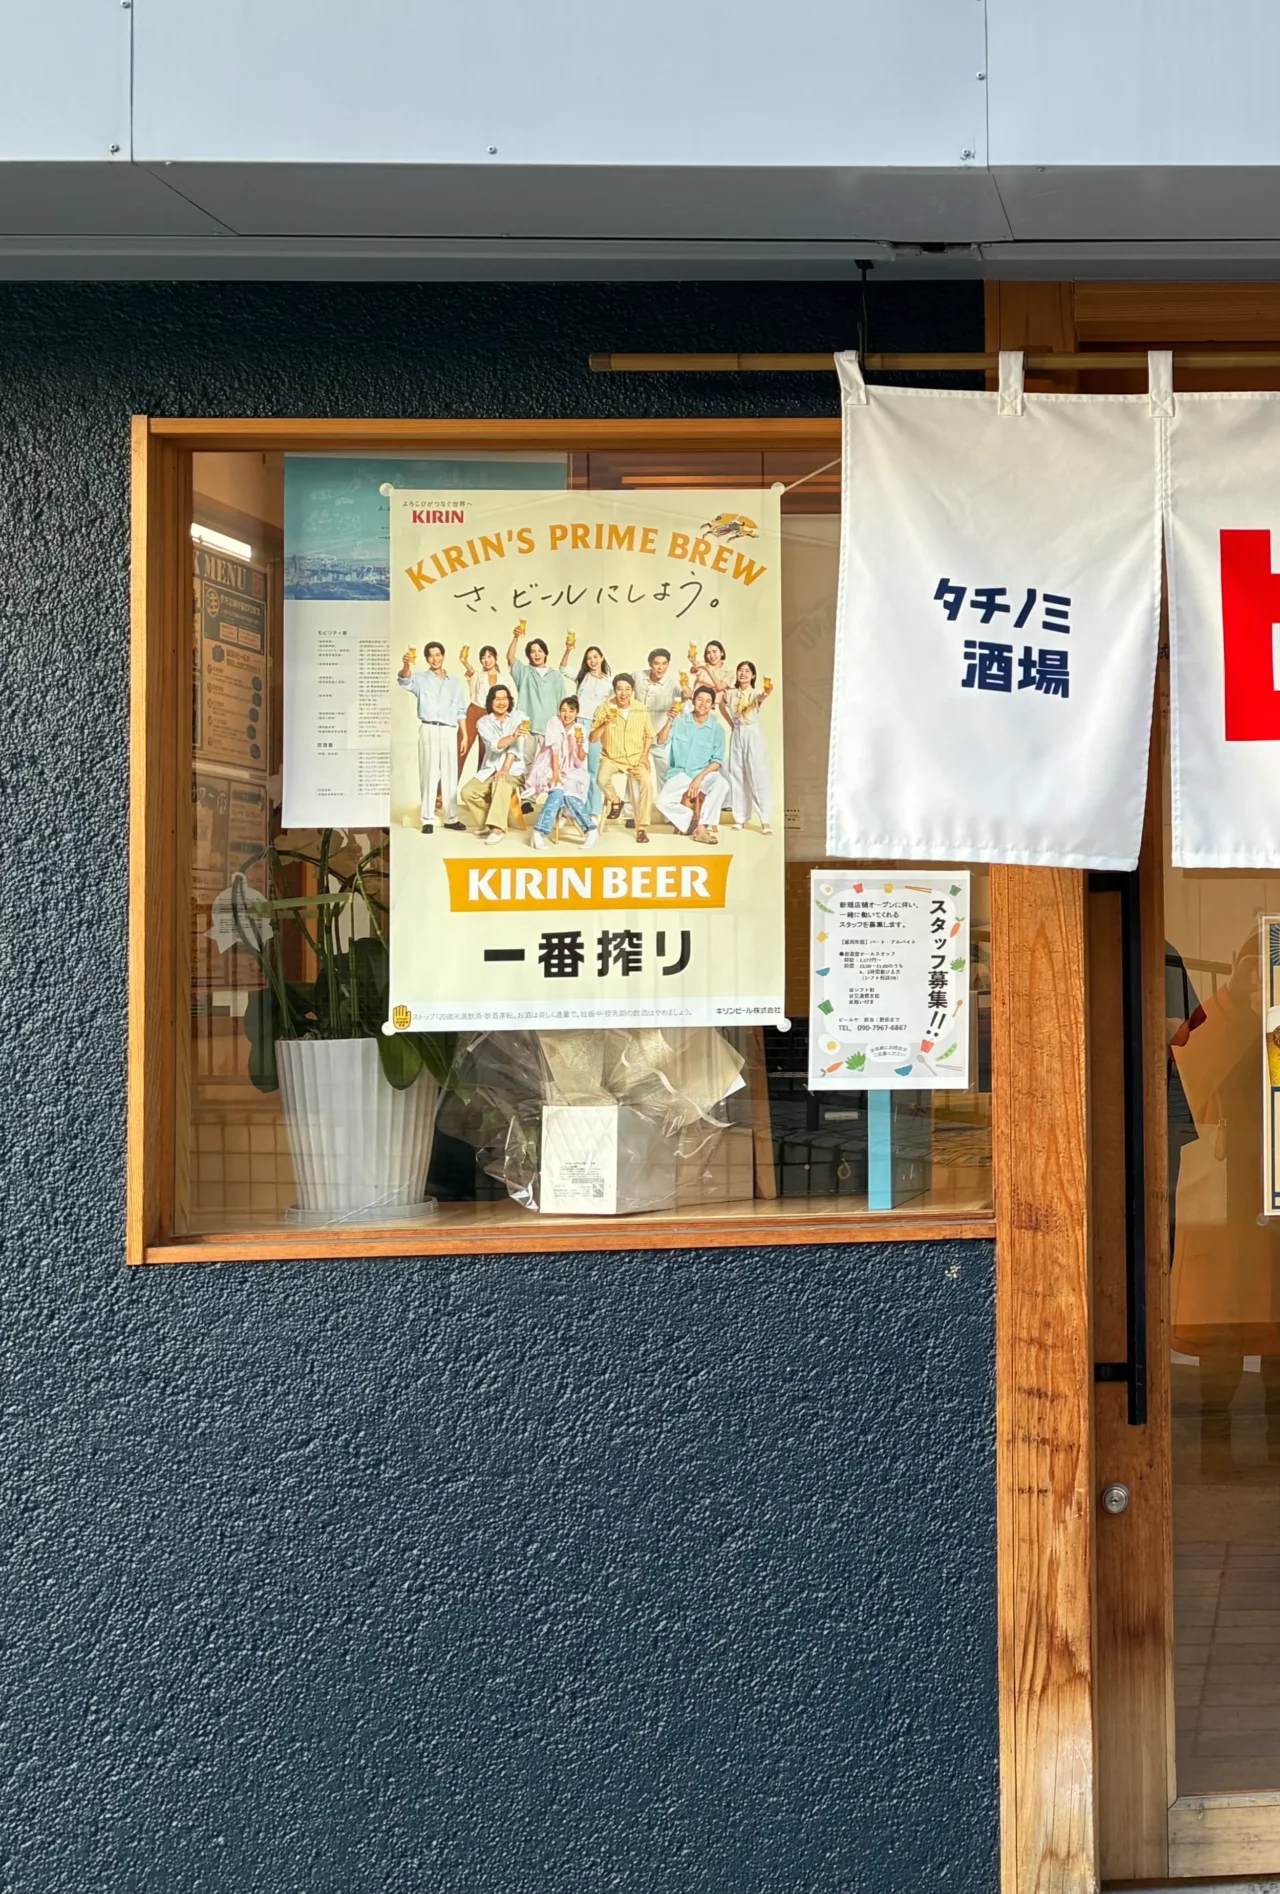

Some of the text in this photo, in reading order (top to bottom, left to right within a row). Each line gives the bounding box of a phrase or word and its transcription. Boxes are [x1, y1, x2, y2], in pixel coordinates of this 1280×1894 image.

[402, 500, 472, 508] よろこびがつなぐ世界へ
[412, 510, 464, 524] KIRIN
[405, 523, 768, 592] KIRIN'S PRIME BREW
[933, 577, 1072, 634] タチノミ
[961, 639, 1070, 698] 酒場
[468, 865, 711, 901] KIRIN BEER
[483, 929, 693, 978] 一番搾り
[716, 1006, 781, 1015] キリンビール株式会社
